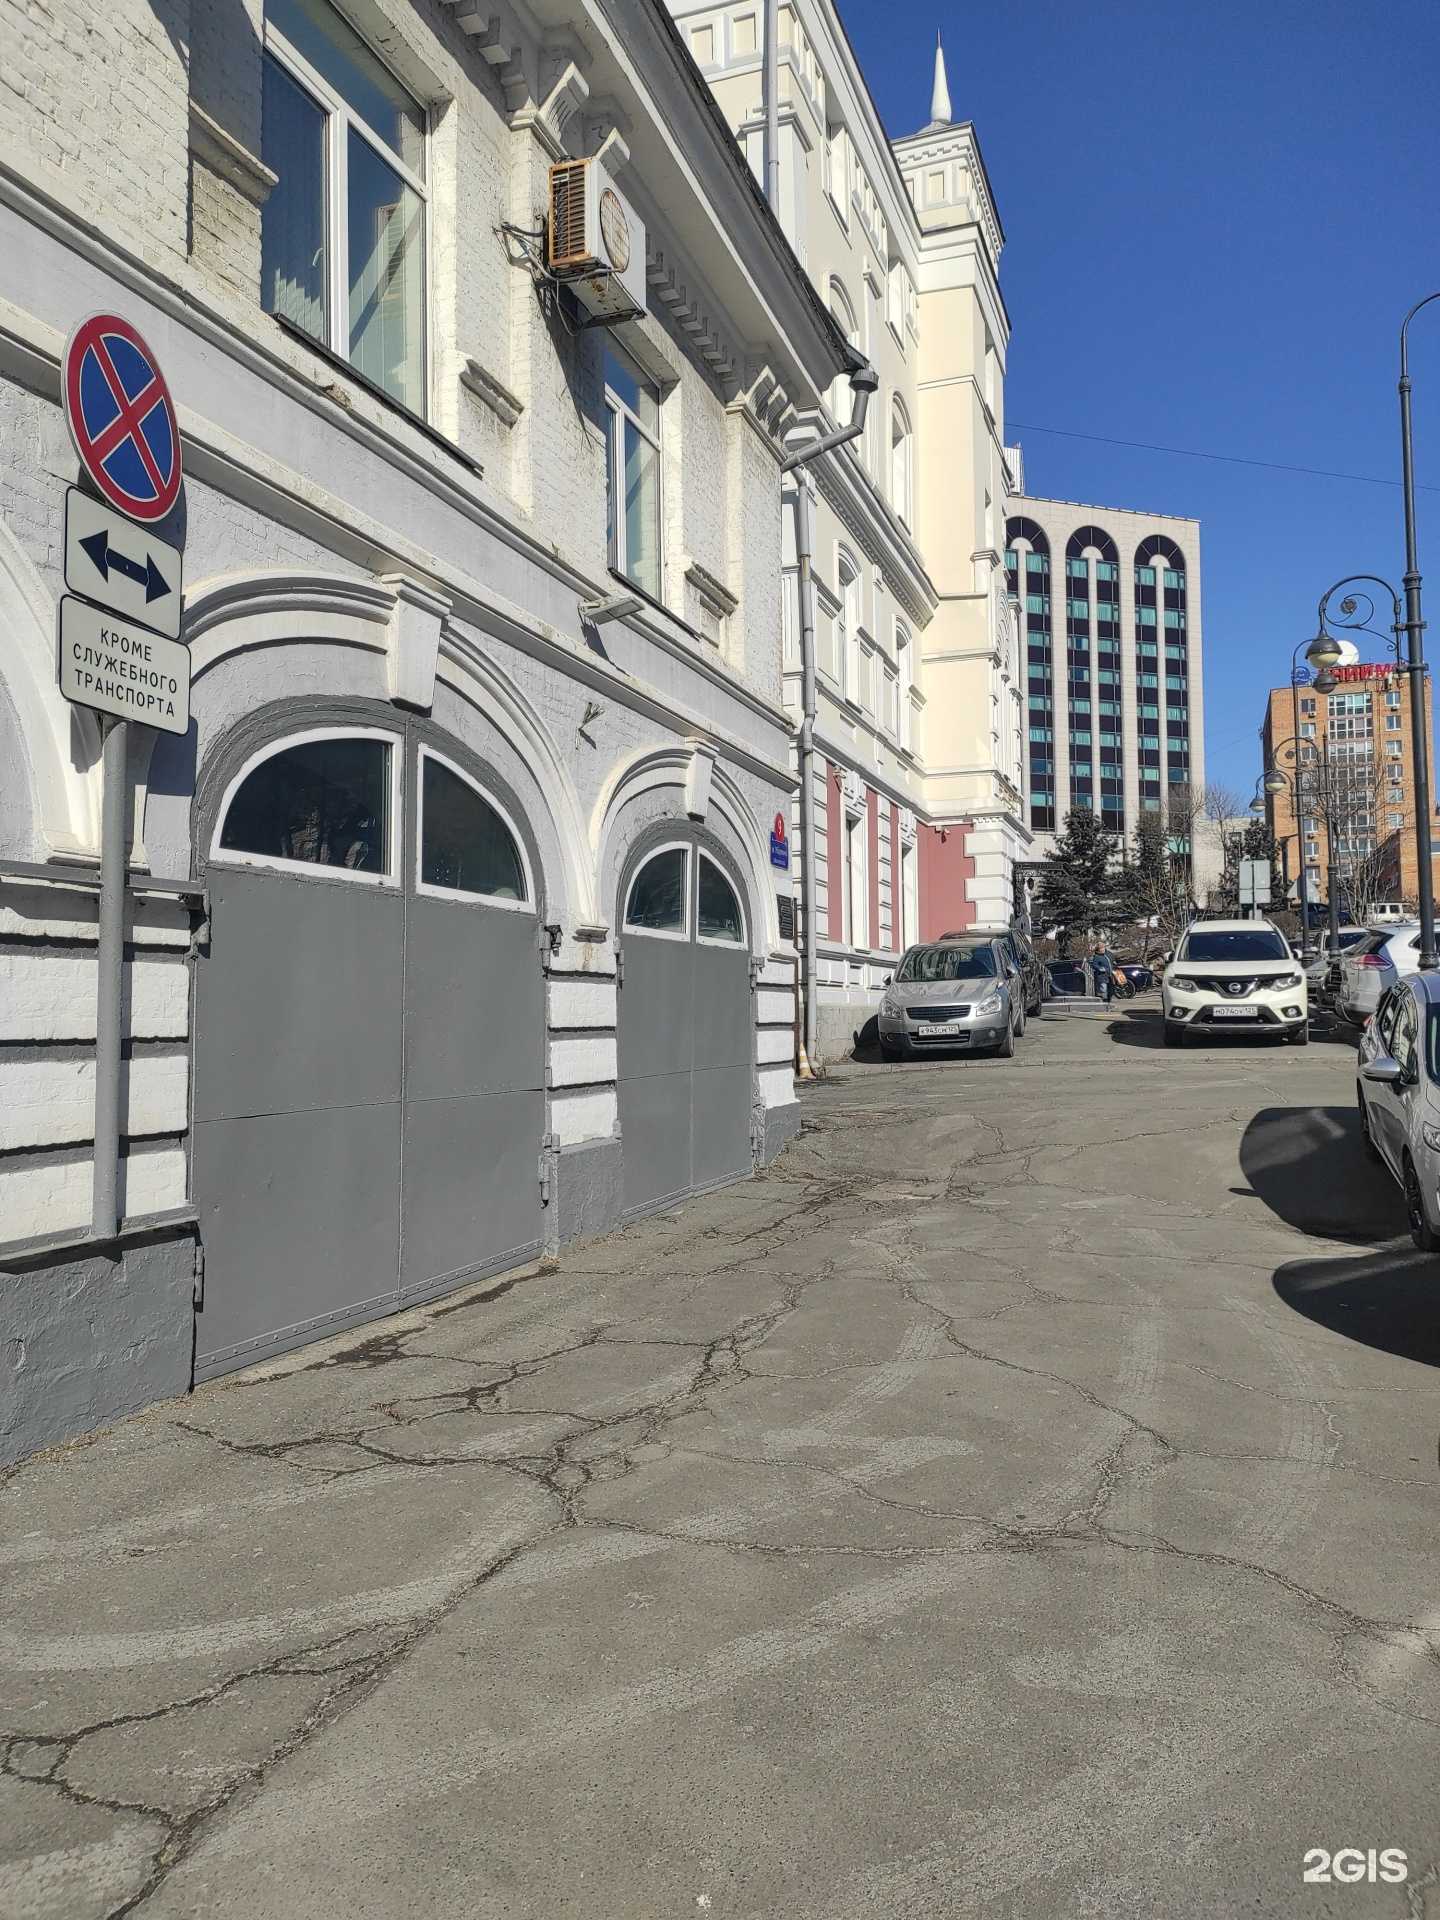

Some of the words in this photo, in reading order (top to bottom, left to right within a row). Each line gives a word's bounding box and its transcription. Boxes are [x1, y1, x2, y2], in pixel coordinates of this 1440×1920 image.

[73, 643, 178, 694] СЛУЖЕБНОГО
[101, 628, 152, 662] КРОМЕ
[74, 669, 175, 718] ТРАНСПОРТА
